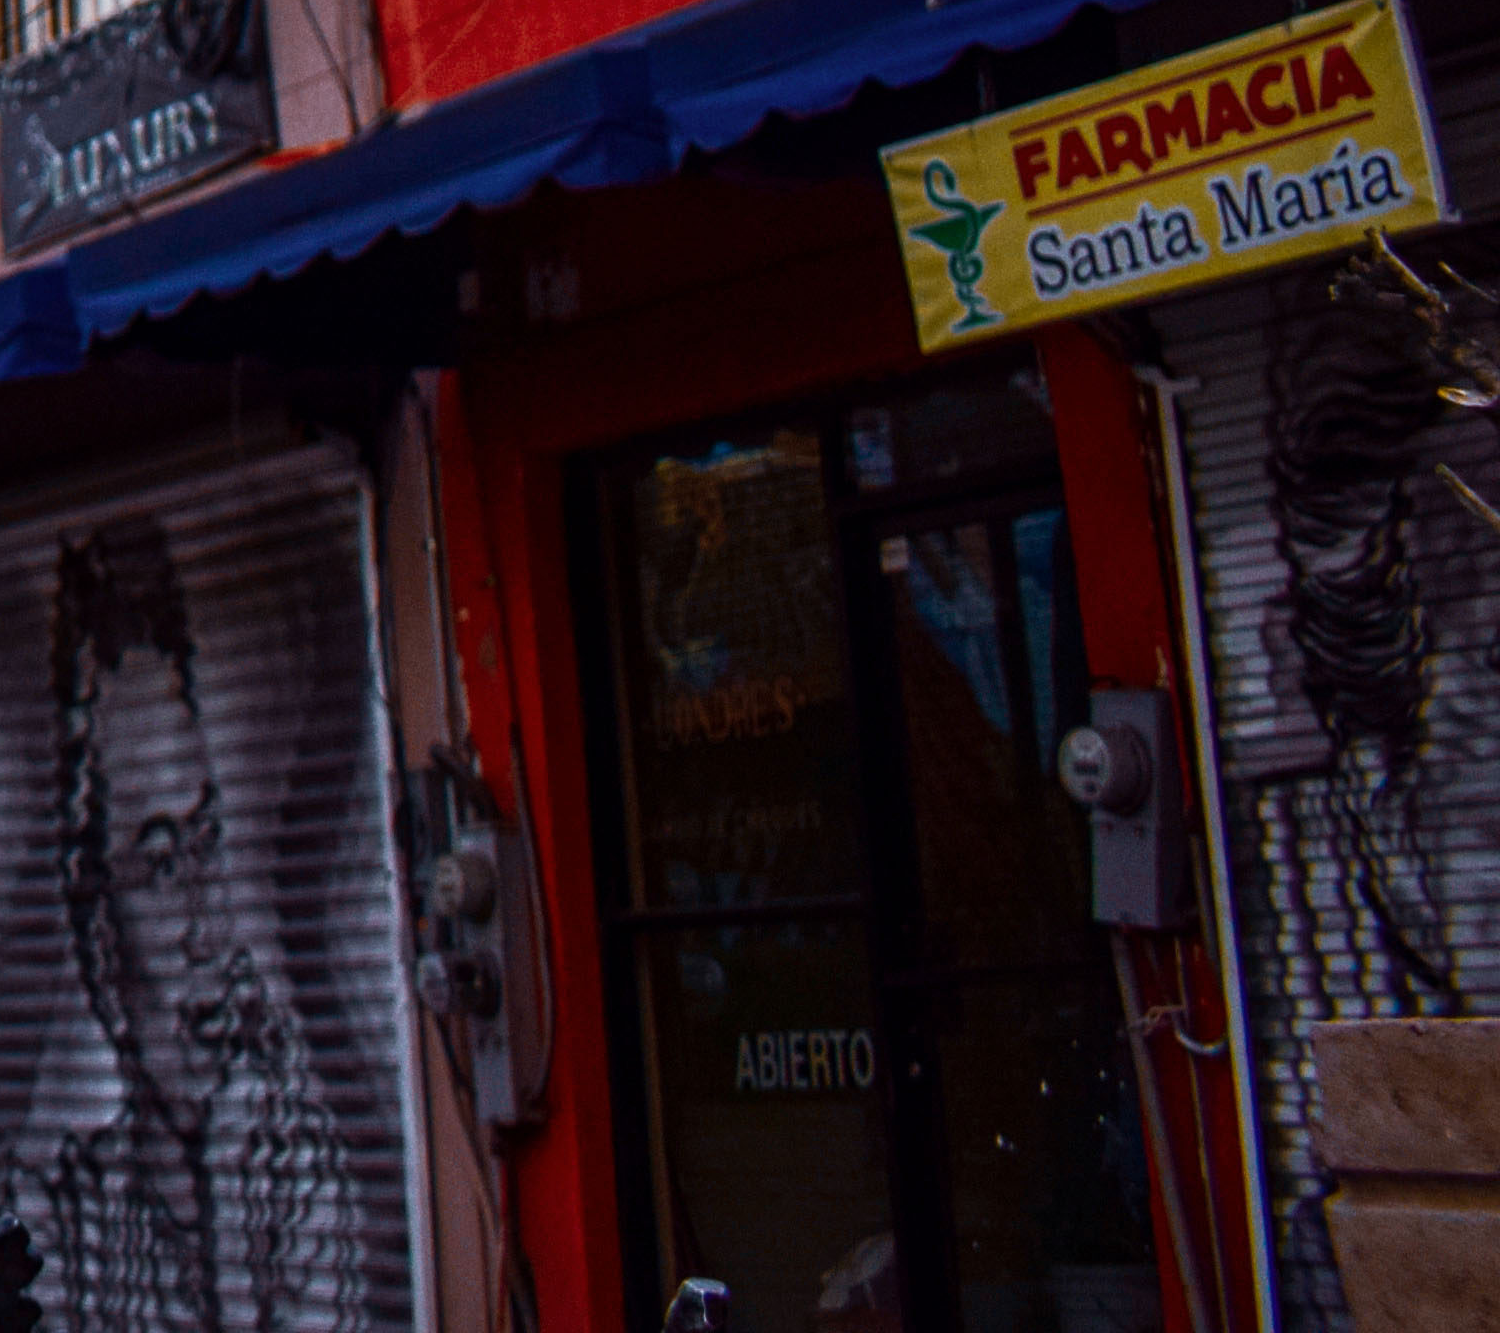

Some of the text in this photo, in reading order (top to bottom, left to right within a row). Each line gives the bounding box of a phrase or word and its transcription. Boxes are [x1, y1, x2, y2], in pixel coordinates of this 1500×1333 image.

[1011, 43, 1374, 200] FARMACIA
[1031, 144, 1403, 295] Santa María
[735, 1030, 876, 1090] ABIERTO
